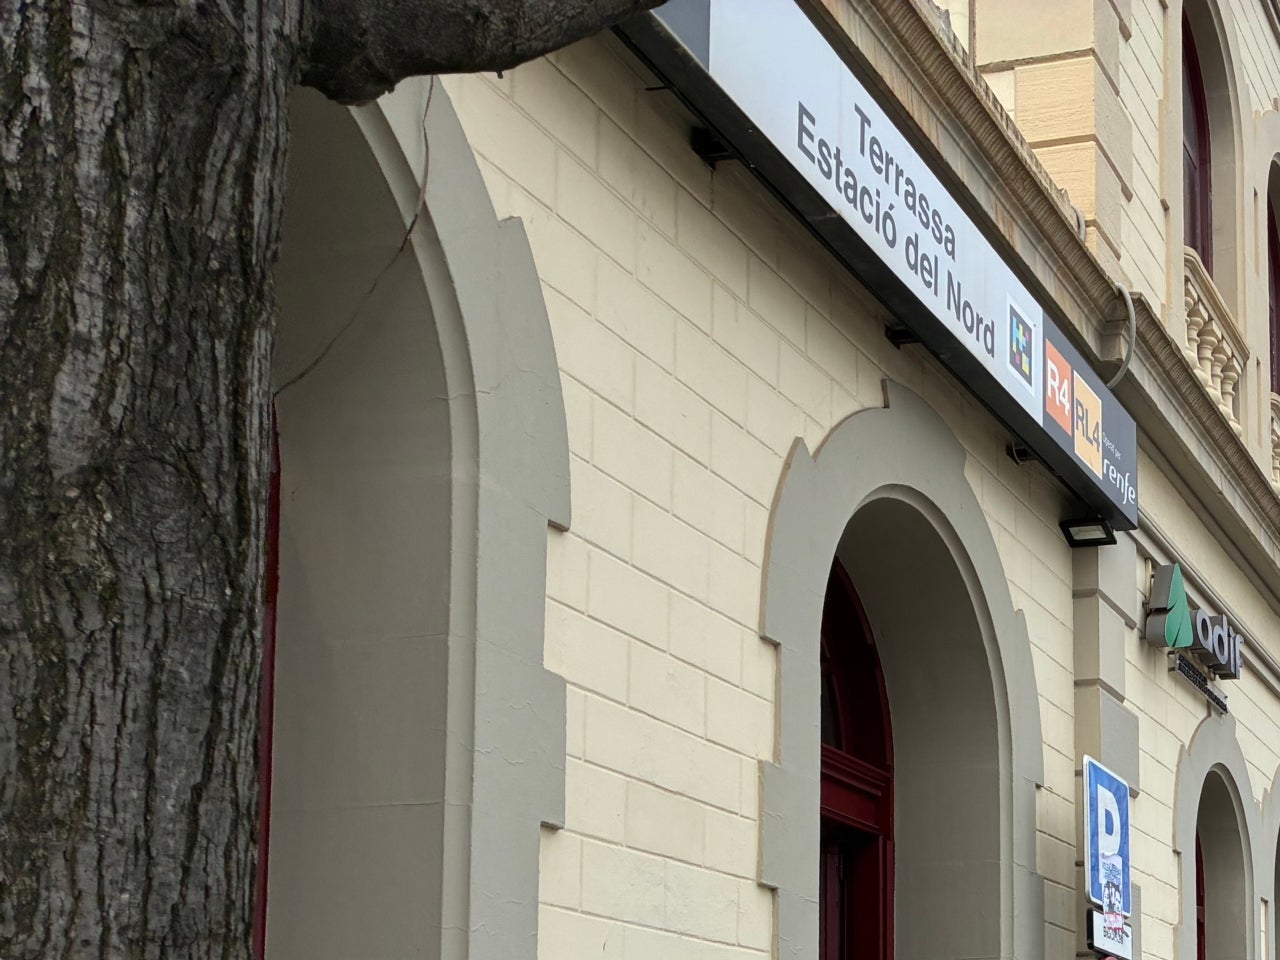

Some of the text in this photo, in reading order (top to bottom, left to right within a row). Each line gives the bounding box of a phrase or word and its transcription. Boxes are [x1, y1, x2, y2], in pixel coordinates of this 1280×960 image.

[854, 102, 956, 262] Terrassa
[797, 100, 995, 359] Estació del Nord
[1047, 358, 1071, 416] R4
[1075, 397, 1101, 453] RL4
[1103, 458, 1136, 504] renfe
[1196, 608, 1245, 680] adif
[1097, 783, 1122, 883] P
